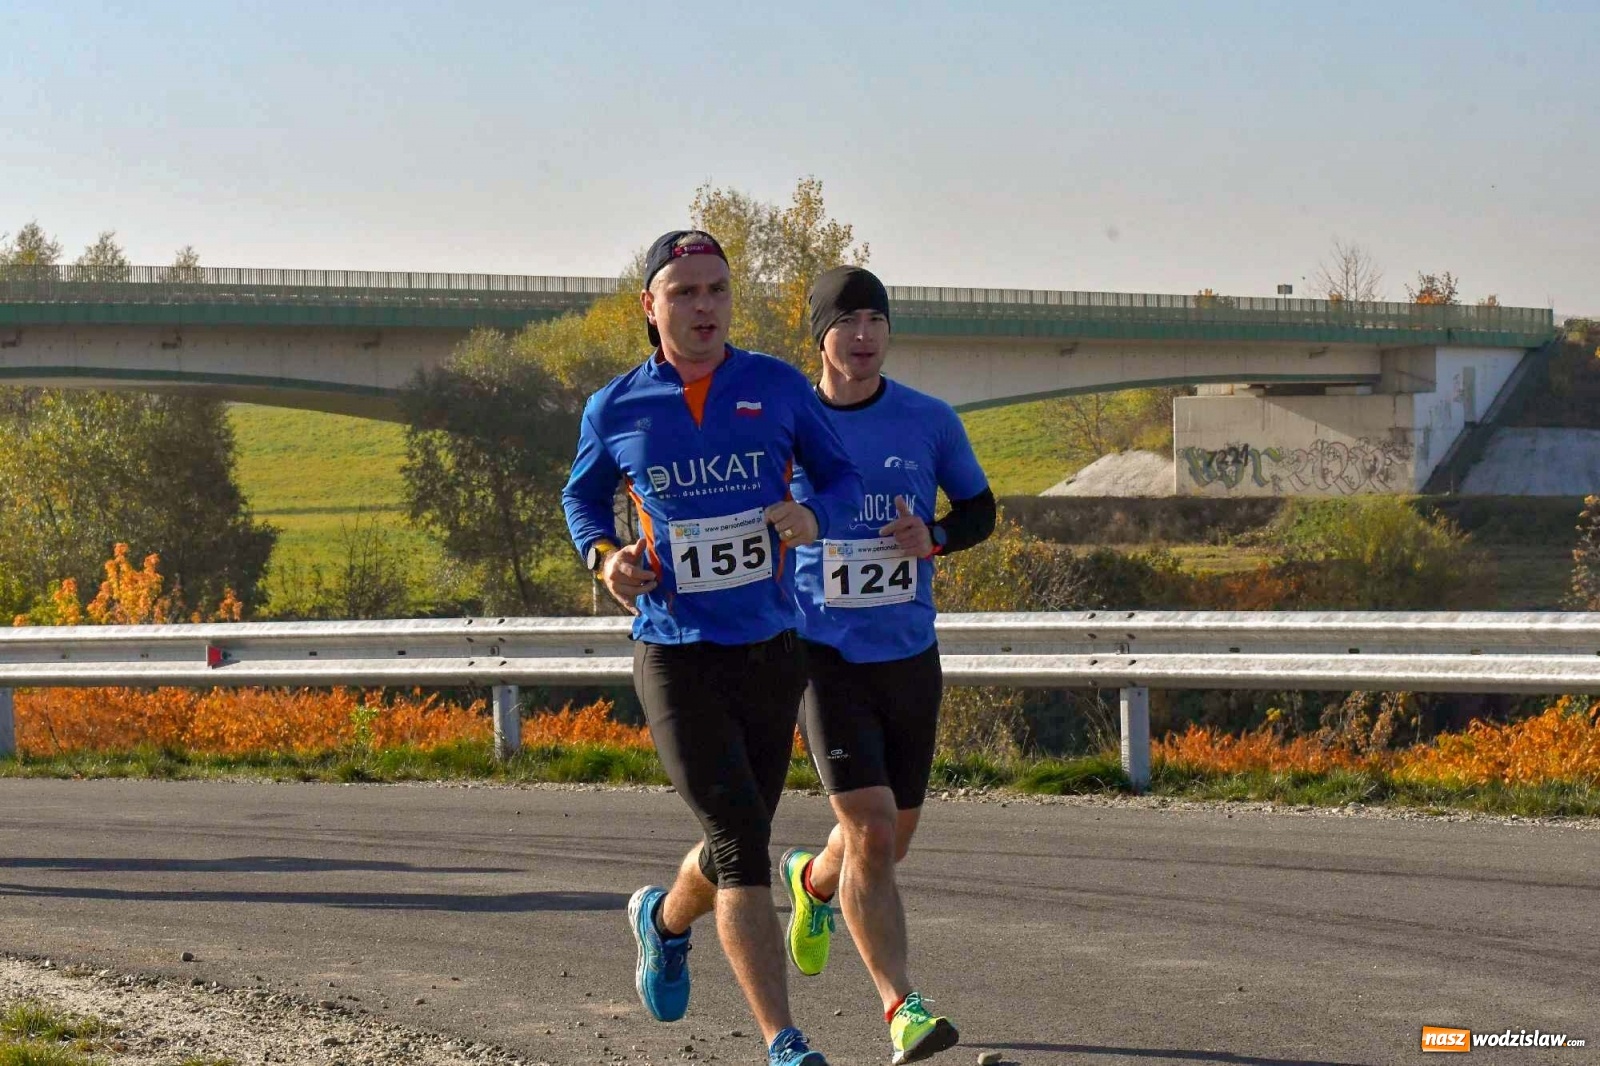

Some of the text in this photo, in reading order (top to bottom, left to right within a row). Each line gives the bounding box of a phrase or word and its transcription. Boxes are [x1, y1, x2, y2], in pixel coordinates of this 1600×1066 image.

[647, 451, 765, 491] DUKAT
[680, 535, 766, 578] 155
[831, 560, 913, 595] 124
